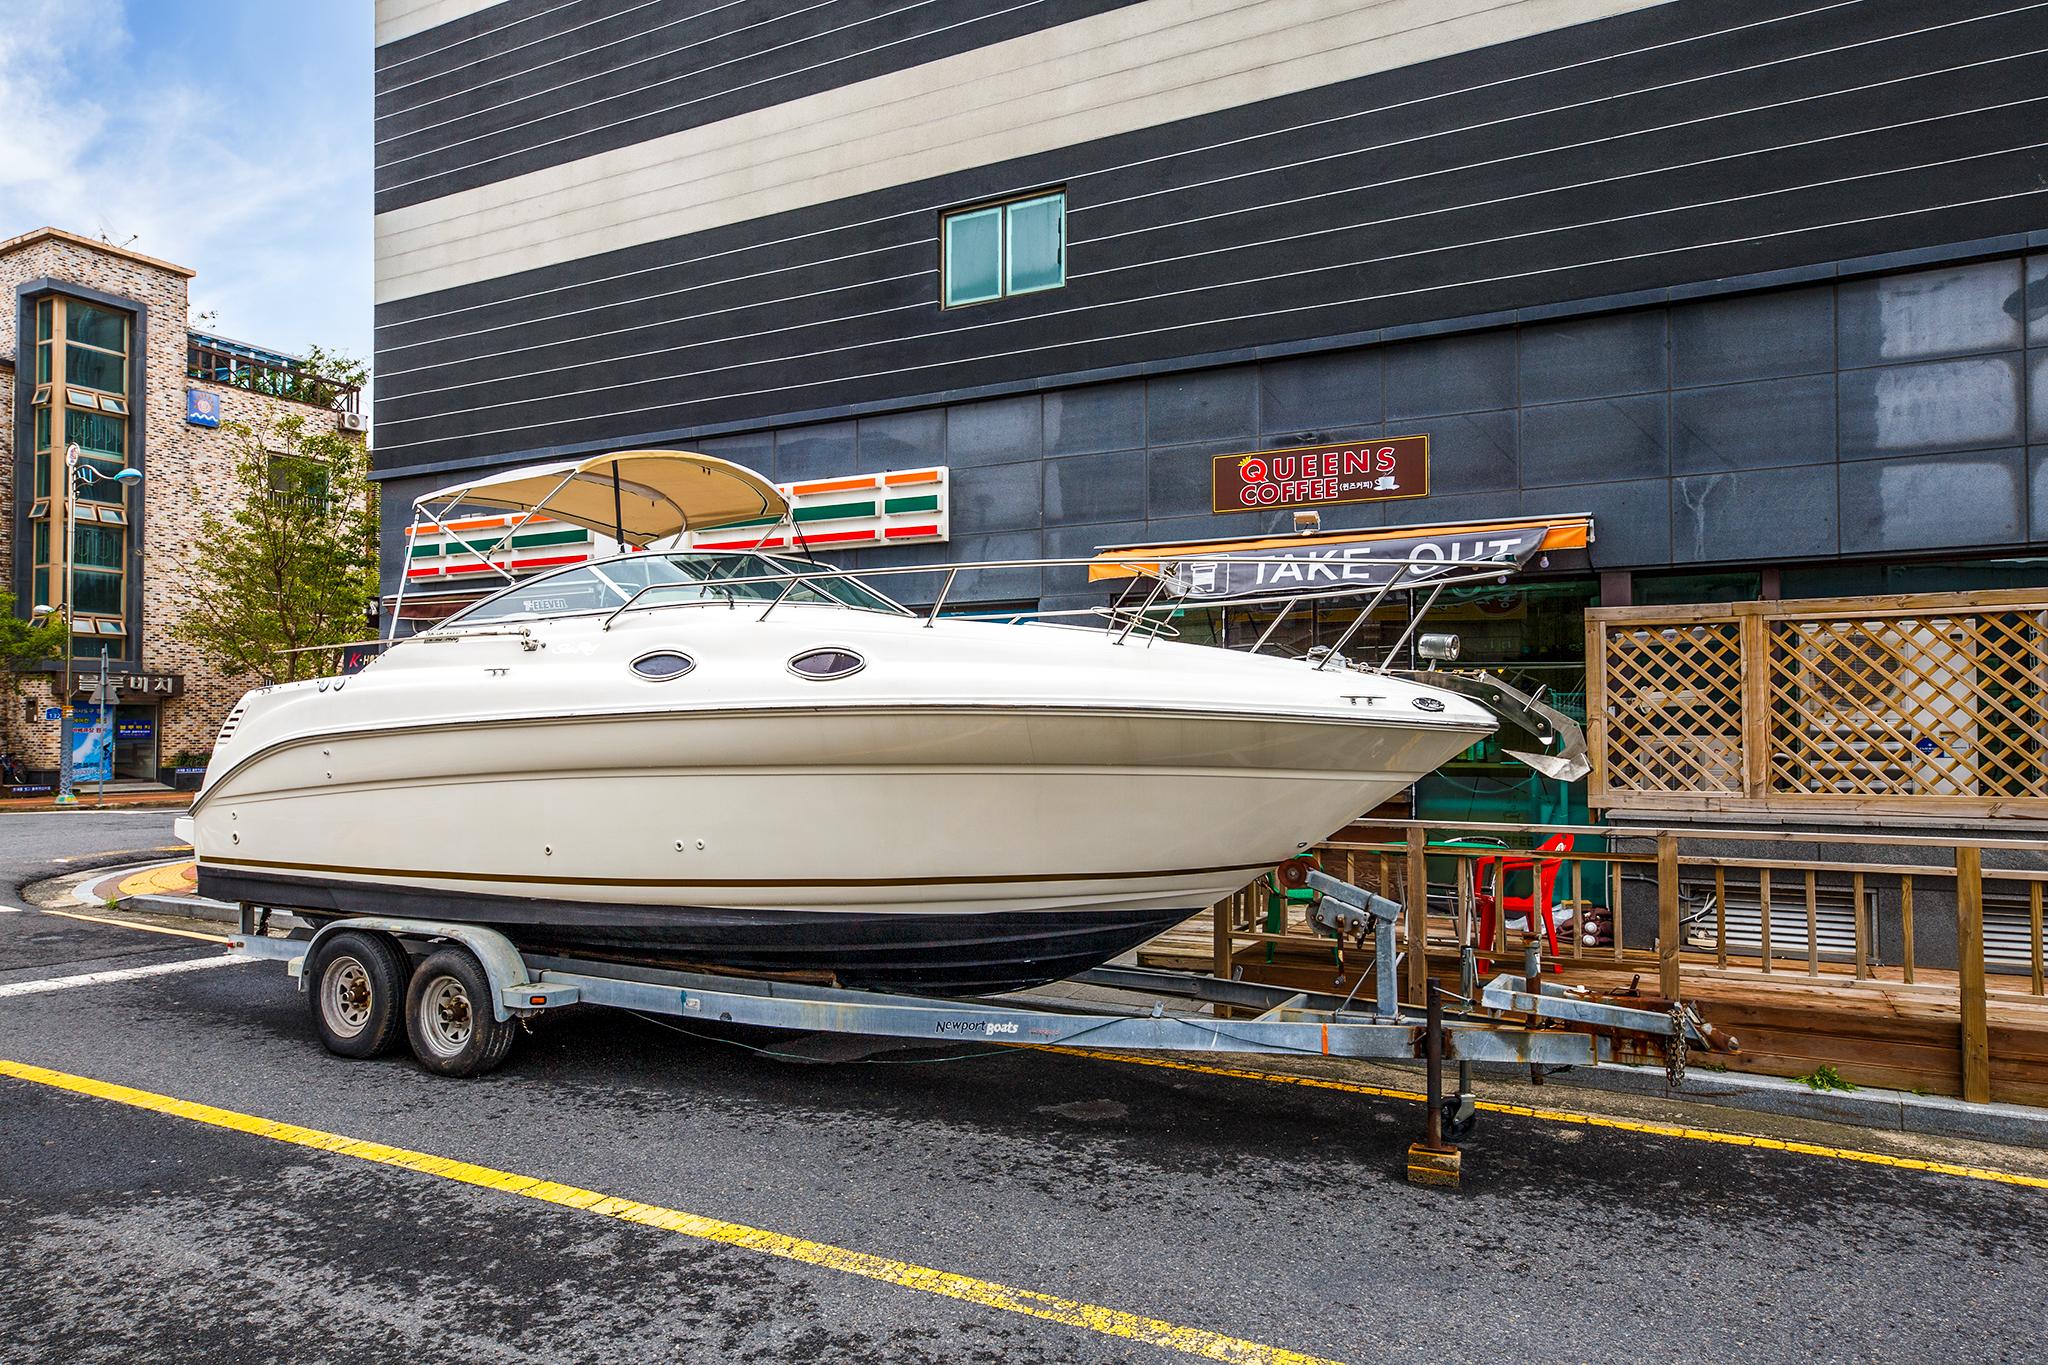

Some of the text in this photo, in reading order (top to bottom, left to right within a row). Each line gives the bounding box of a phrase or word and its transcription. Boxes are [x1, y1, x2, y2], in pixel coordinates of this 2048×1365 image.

[1240, 446, 1396, 484] QUEENS
[1240, 477, 1338, 505] COFFEE
[1254, 537, 1522, 585] TAKE OUT
[935, 1020, 985, 1033] Newport
